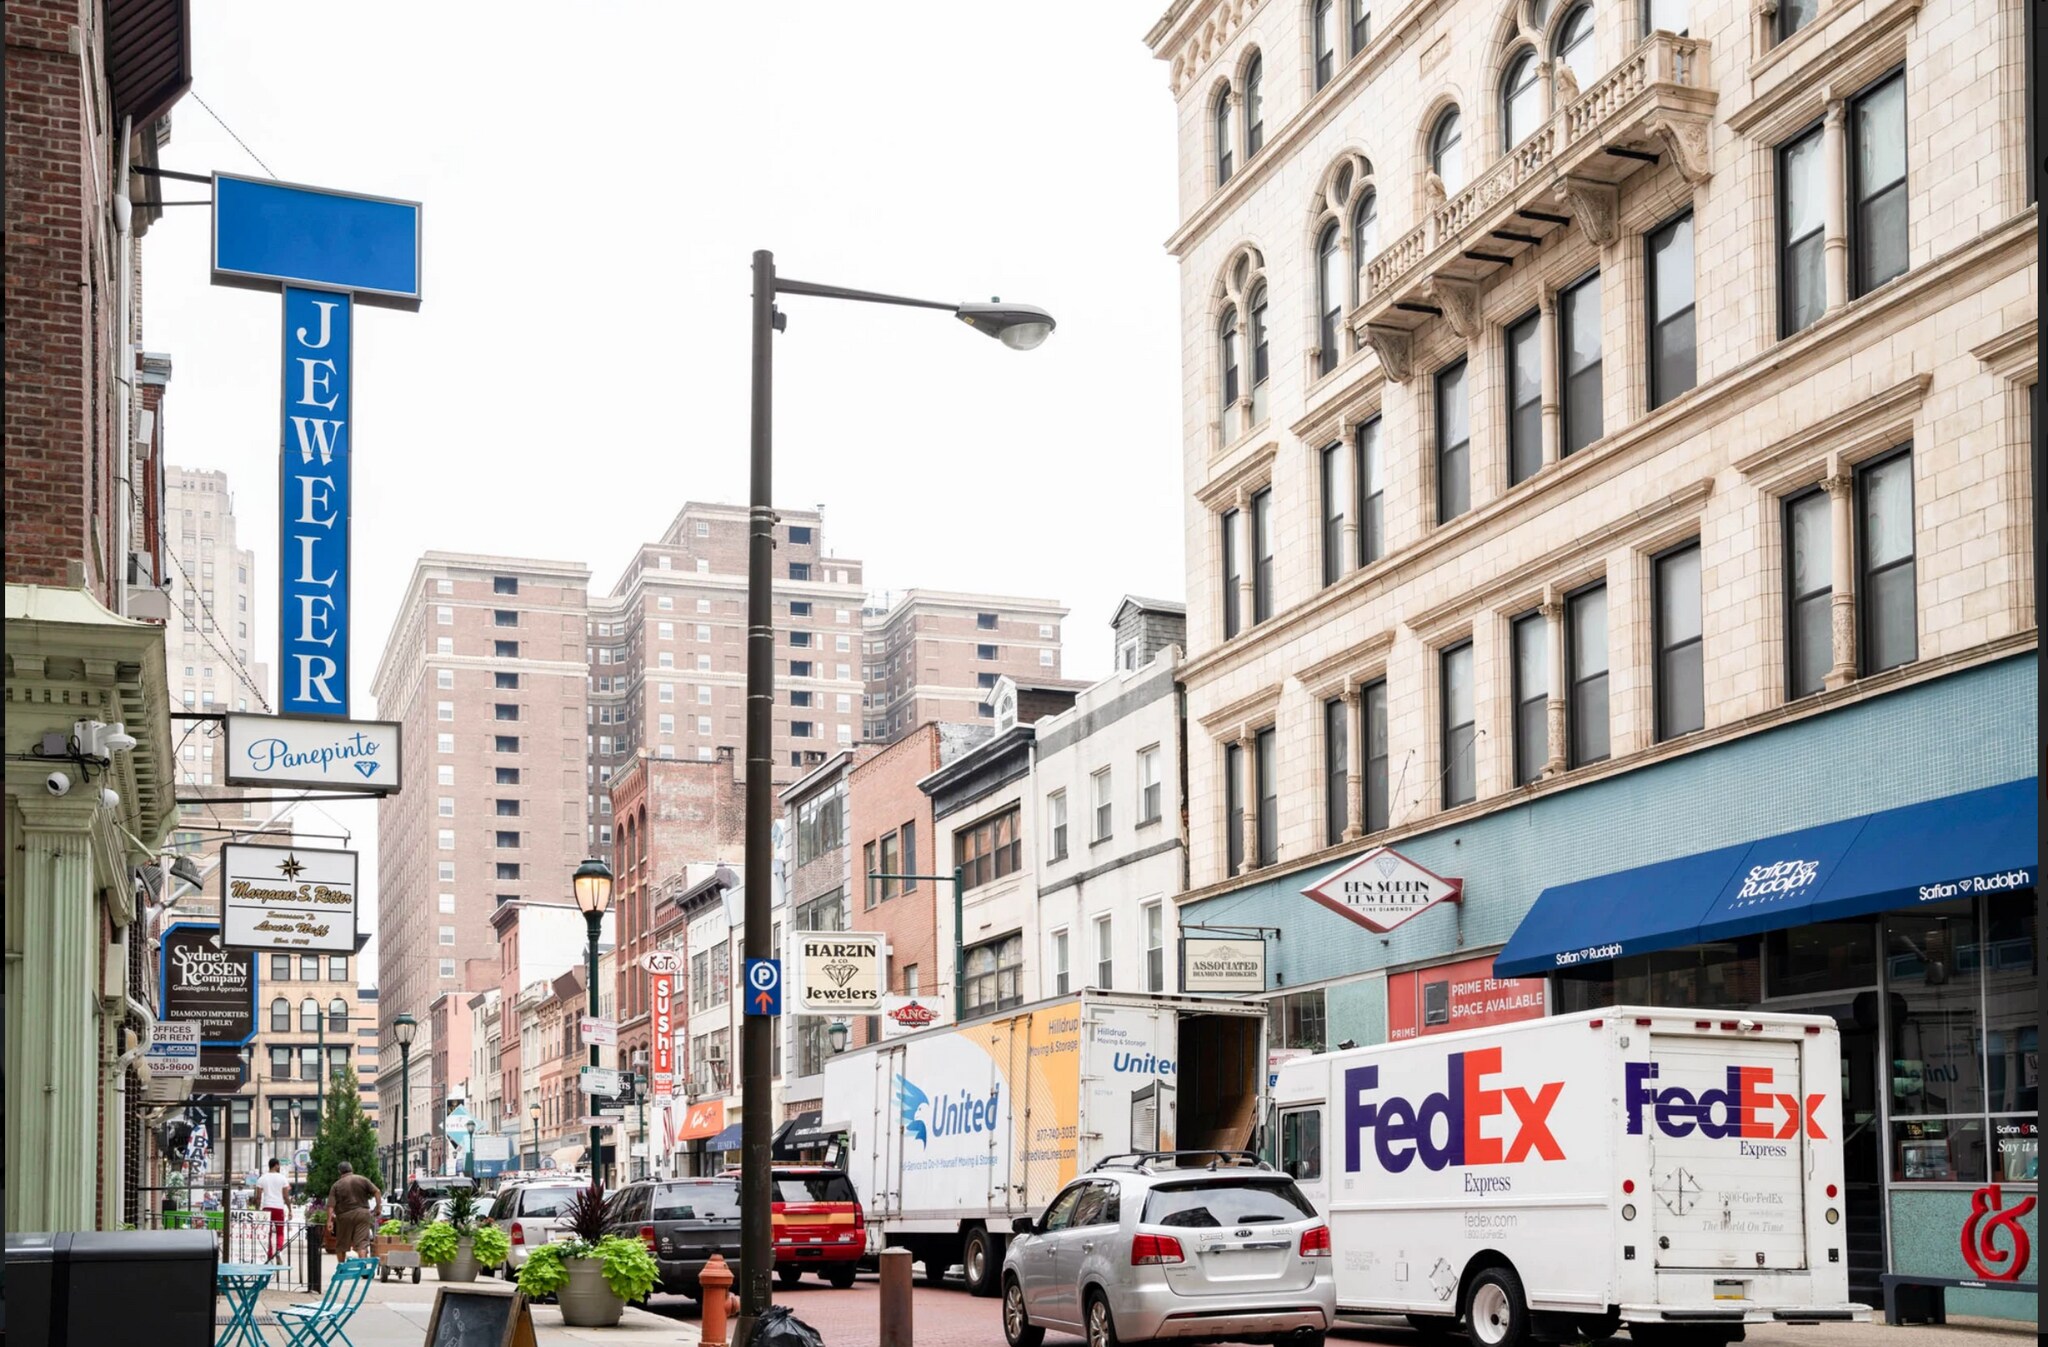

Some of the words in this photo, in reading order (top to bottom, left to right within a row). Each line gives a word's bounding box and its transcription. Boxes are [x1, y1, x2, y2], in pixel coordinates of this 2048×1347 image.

[290, 301, 344, 704] JEWELER
[247, 732, 380, 773] Panepinto
[1744, 860, 1804, 883] Safian
[1345, 881, 1372, 893] BEN
[1377, 881, 1429, 892] SORKIN
[1736, 868, 1817, 899] Rudolph
[1919, 883, 1958, 901] Safian
[1974, 870, 2029, 892] Rudolph
[231, 880, 297, 904] Maryanne
[297, 885, 312, 902] S.
[314, 885, 352, 905] Ritter
[1347, 894, 1429, 904] JEWELERS
[1728, 889, 1806, 910] JEWELERS
[172, 945, 228, 966] Sydney
[805, 944, 876, 957] HARZIN
[1556, 951, 1580, 965] Safian
[1589, 943, 1622, 959] Rudolph
[181, 961, 247, 986] ROSEN
[1193, 961, 1258, 970] ASSOCIATED
[758, 969, 770, 984] P
[172, 985, 209, 993] Gemologists
[806, 986, 877, 999] Jewelers
[1451, 980, 1482, 997] PRIME
[1484, 978, 1520, 991] RETAIL
[1452, 1002, 1483, 1018] SPACE
[1485, 992, 1543, 1013] AVAILABLE
[1049, 1018, 1078, 1034] Hilldrup
[1097, 1027, 1127, 1038] Hilldrup
[1391, 1027, 1416, 1039] PRIME
[1055, 1040, 1078, 1054] Storage
[1097, 1038, 1118, 1046] Moving
[1124, 1039, 1146, 1048] Storage
[932, 1082, 1000, 1137] United
[1625, 1062, 1828, 1140] FedEx
[1344, 1046, 1566, 1174] FedEx
[1996, 1125, 2020, 1134] Safian
[1740, 1140, 1787, 1159] Express
[1997, 1139, 2020, 1155] Say
[2022, 1139, 2031, 1151] it
[979, 1154, 998, 1166] Storage
[1464, 1172, 1511, 1196] Express
[1464, 1212, 1517, 1228] fedex.com
[1747, 1222, 1759, 1232] On
[1762, 1222, 1784, 1232] Time
